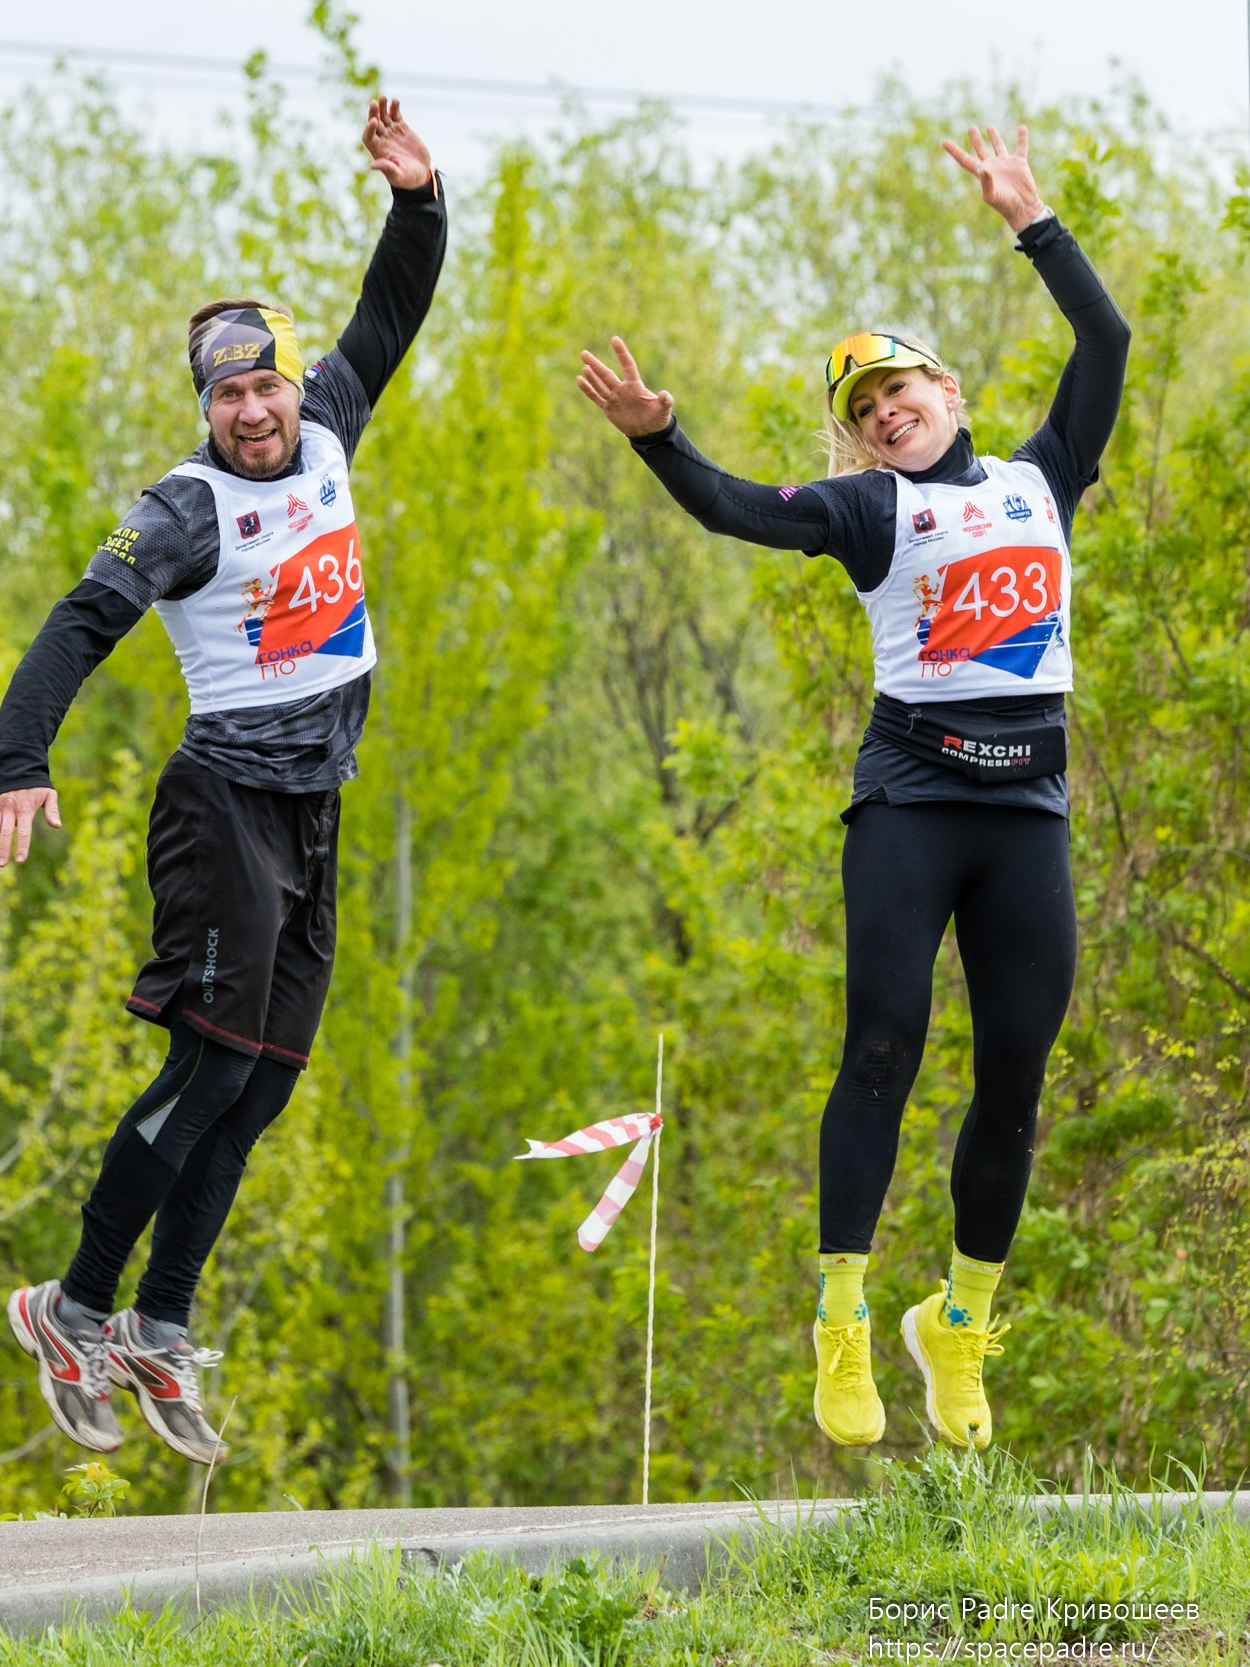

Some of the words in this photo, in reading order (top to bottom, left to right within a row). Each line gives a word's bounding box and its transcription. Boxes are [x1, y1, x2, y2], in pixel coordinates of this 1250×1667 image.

[111, 527, 140, 542] АЛИ
[288, 538, 362, 613] 436
[953, 562, 1048, 620] 433
[260, 659, 296, 680] ГТО
[921, 661, 952, 678] ГТО
[943, 735, 1031, 757] REXCHI
[202, 927, 219, 1004] OUTSHOCK
